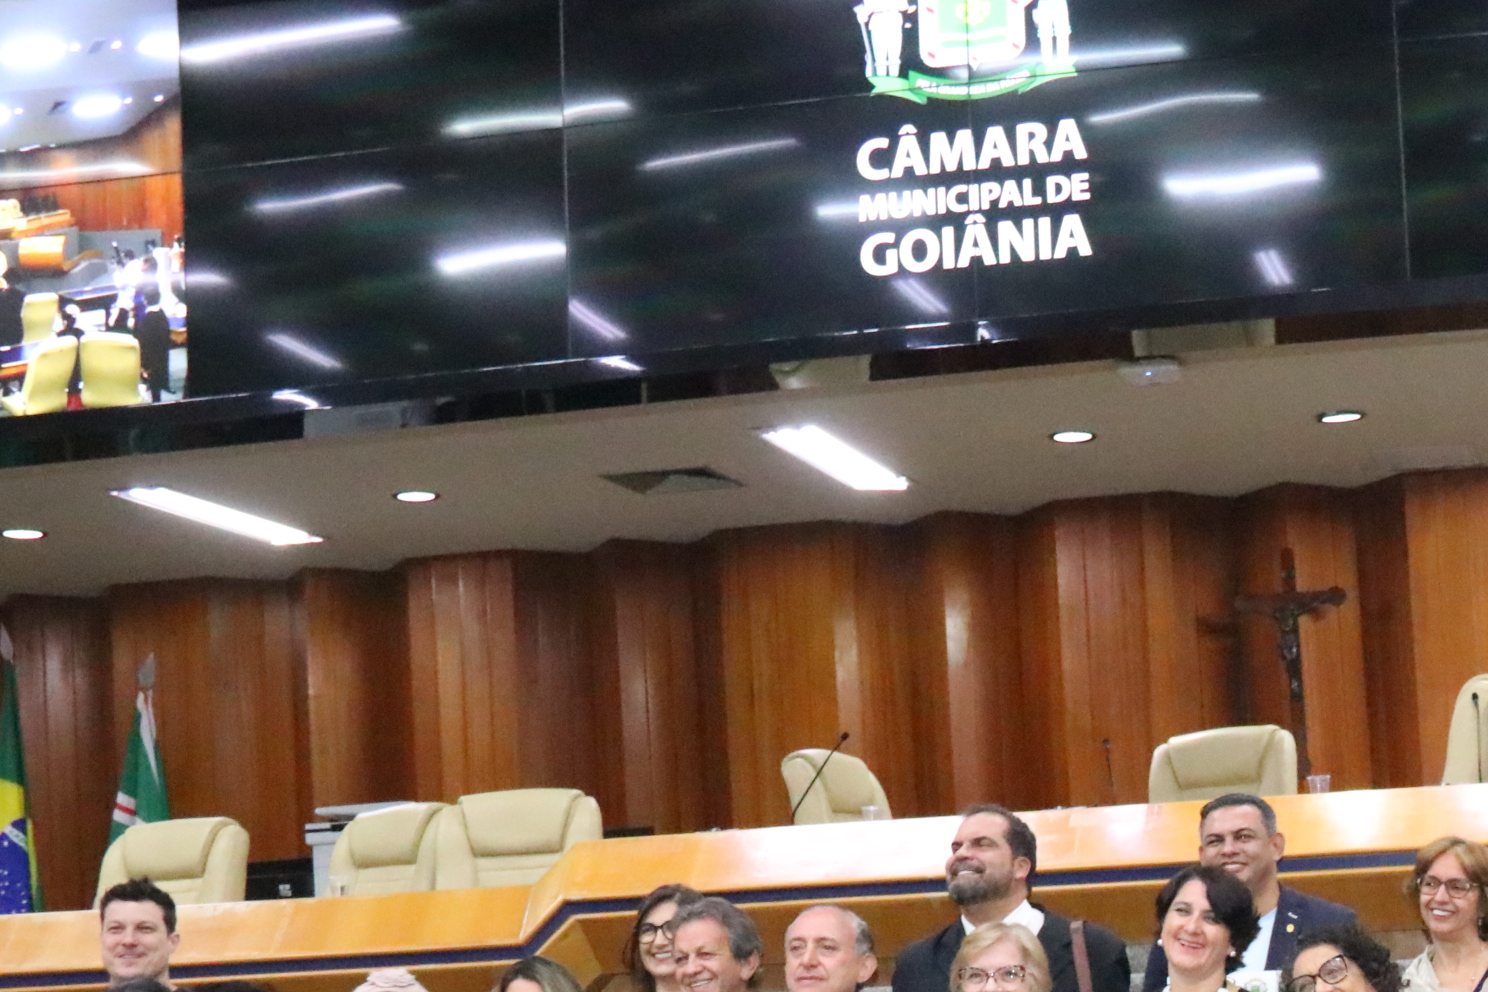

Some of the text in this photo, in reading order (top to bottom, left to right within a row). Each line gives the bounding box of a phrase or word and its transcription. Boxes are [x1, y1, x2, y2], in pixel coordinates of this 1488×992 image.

[856, 118, 1088, 181] CÂMARA
[858, 172, 1091, 223] MUNICIPAL DE
[860, 213, 1093, 277] GOIÂNIA
